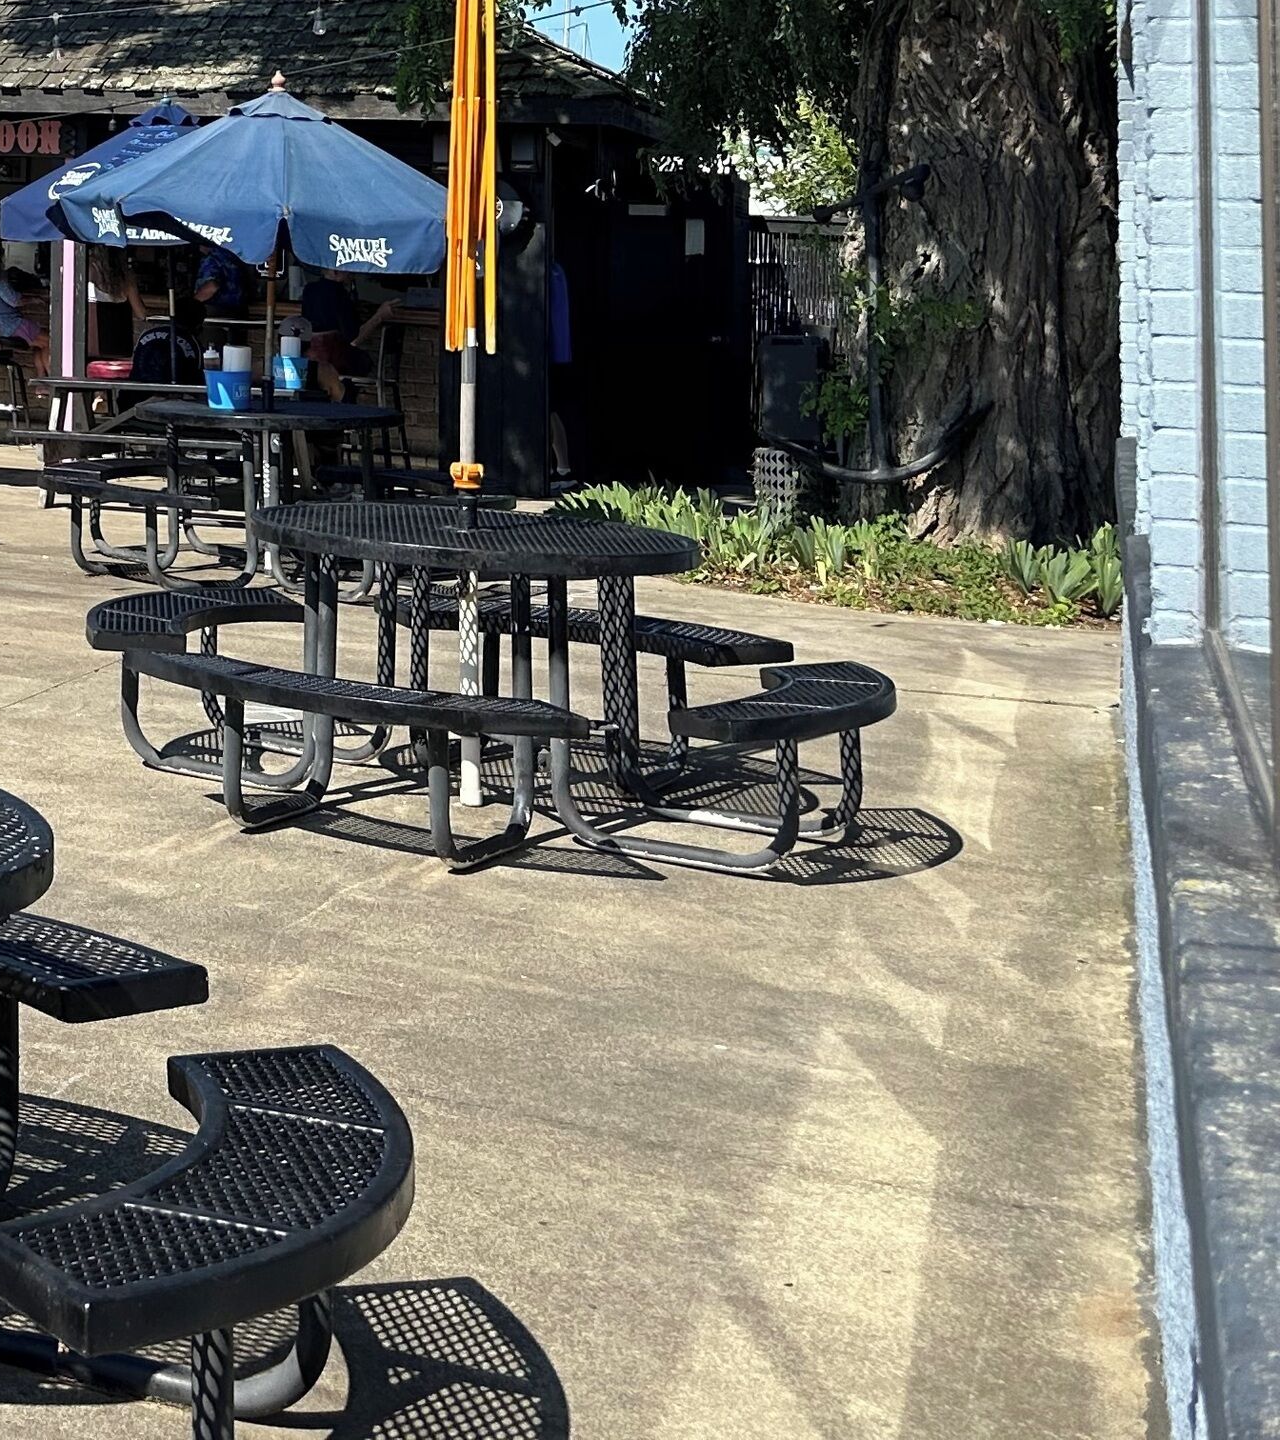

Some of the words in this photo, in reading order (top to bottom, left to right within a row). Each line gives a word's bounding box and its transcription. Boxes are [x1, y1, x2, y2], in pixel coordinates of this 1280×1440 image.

[140, 228, 182, 241] ADAM
[173, 216, 234, 245] MUEL
[329, 234, 393, 254] SAMUEL
[336, 249, 388, 268] ADAMS
